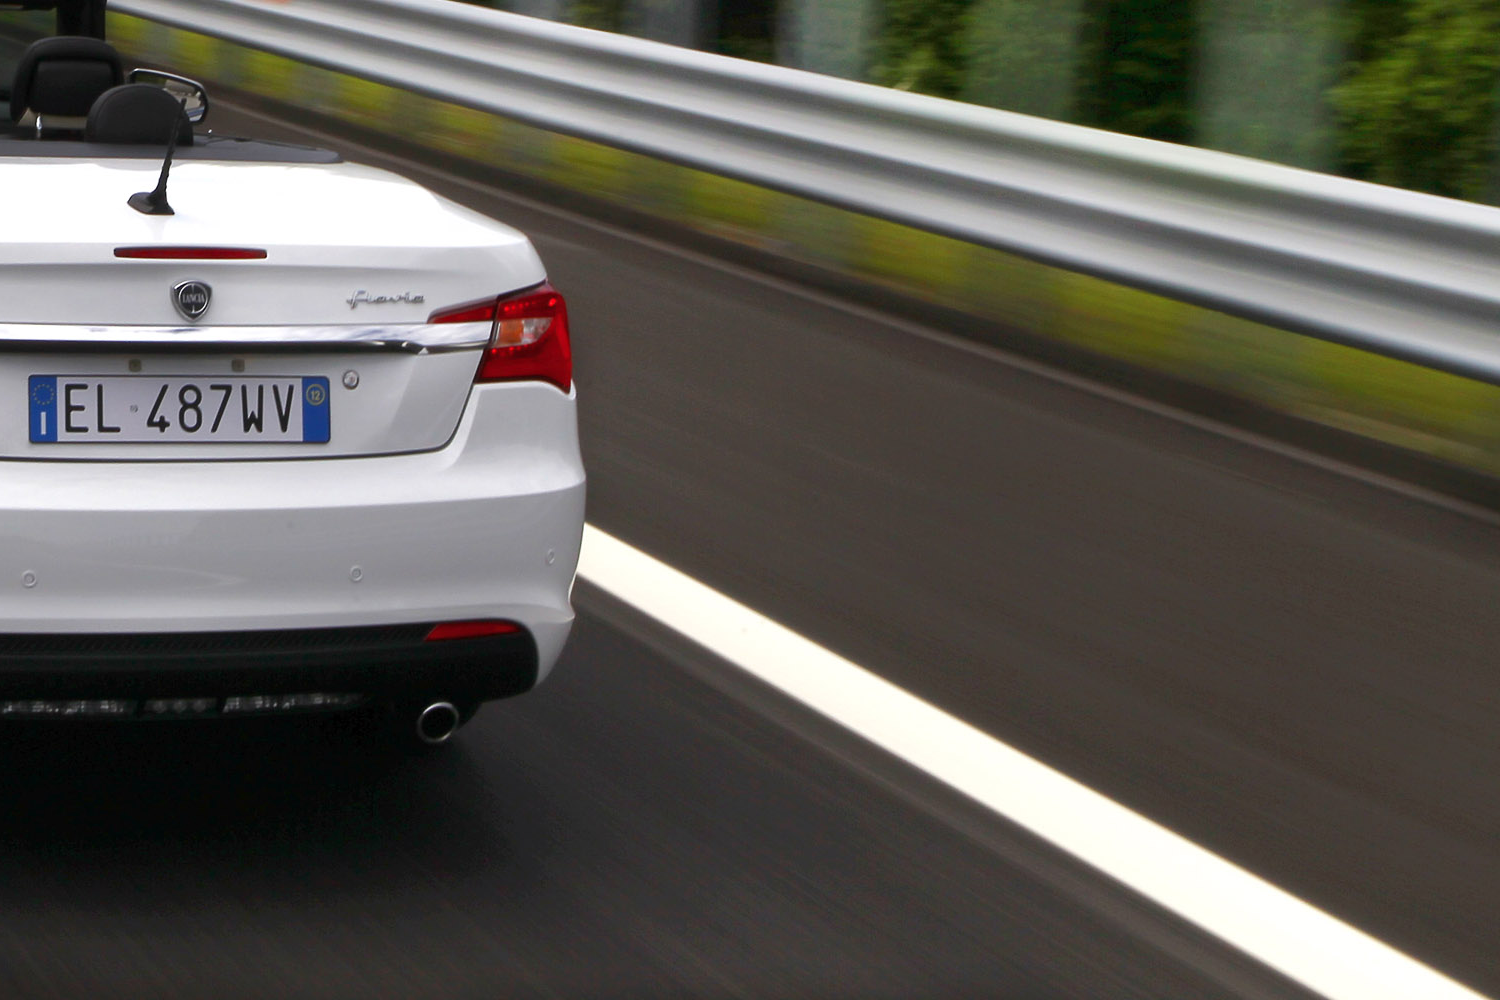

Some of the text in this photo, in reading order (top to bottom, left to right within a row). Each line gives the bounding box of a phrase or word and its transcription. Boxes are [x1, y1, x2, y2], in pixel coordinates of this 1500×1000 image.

[65, 383, 295, 433] EL 487WV
[311, 390, 321, 401] 12
